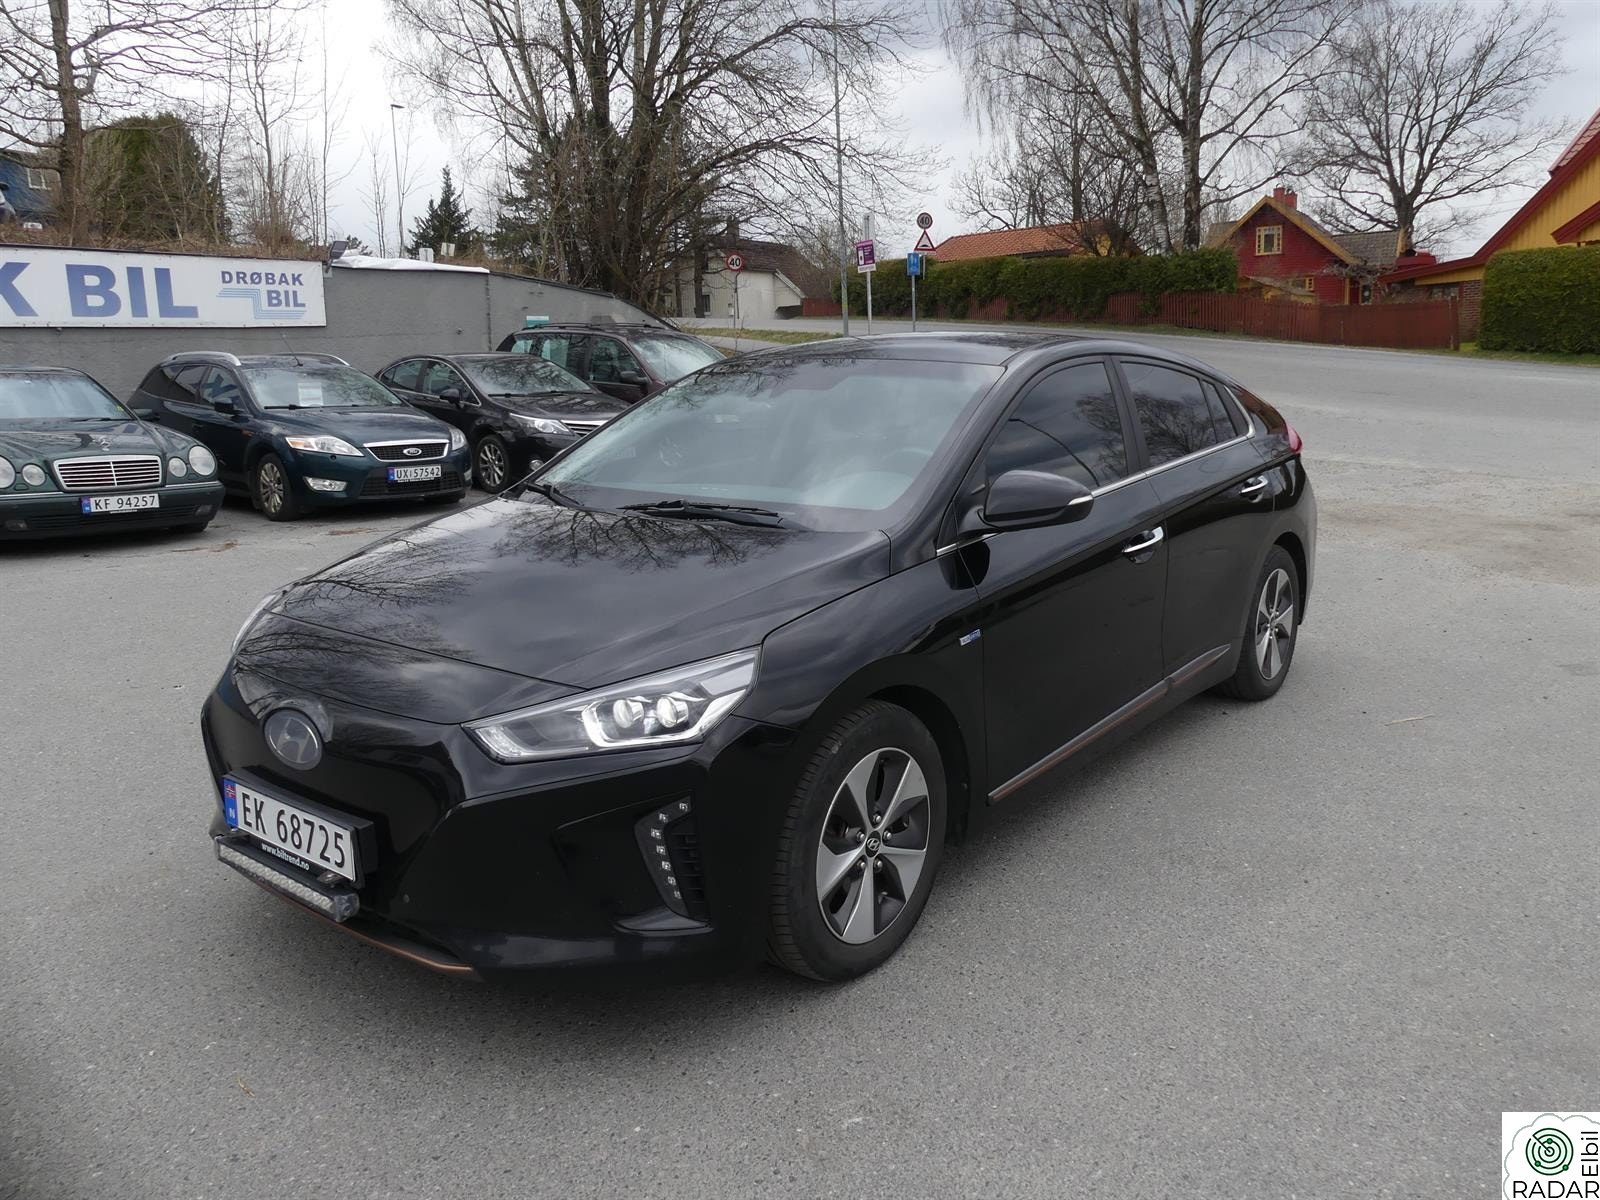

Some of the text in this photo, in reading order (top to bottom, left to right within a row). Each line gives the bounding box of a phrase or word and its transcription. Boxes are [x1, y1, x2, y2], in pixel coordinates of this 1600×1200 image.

[919, 216, 929, 225] 40
[730, 257, 741, 267] 40
[221, 270, 304, 286] DRØBAK
[65, 264, 199, 318] BIL
[266, 289, 306, 308] BIL
[396, 466, 440, 479] UX 57542
[94, 495, 155, 510] KF 94257
[241, 791, 346, 869] EK 68725
